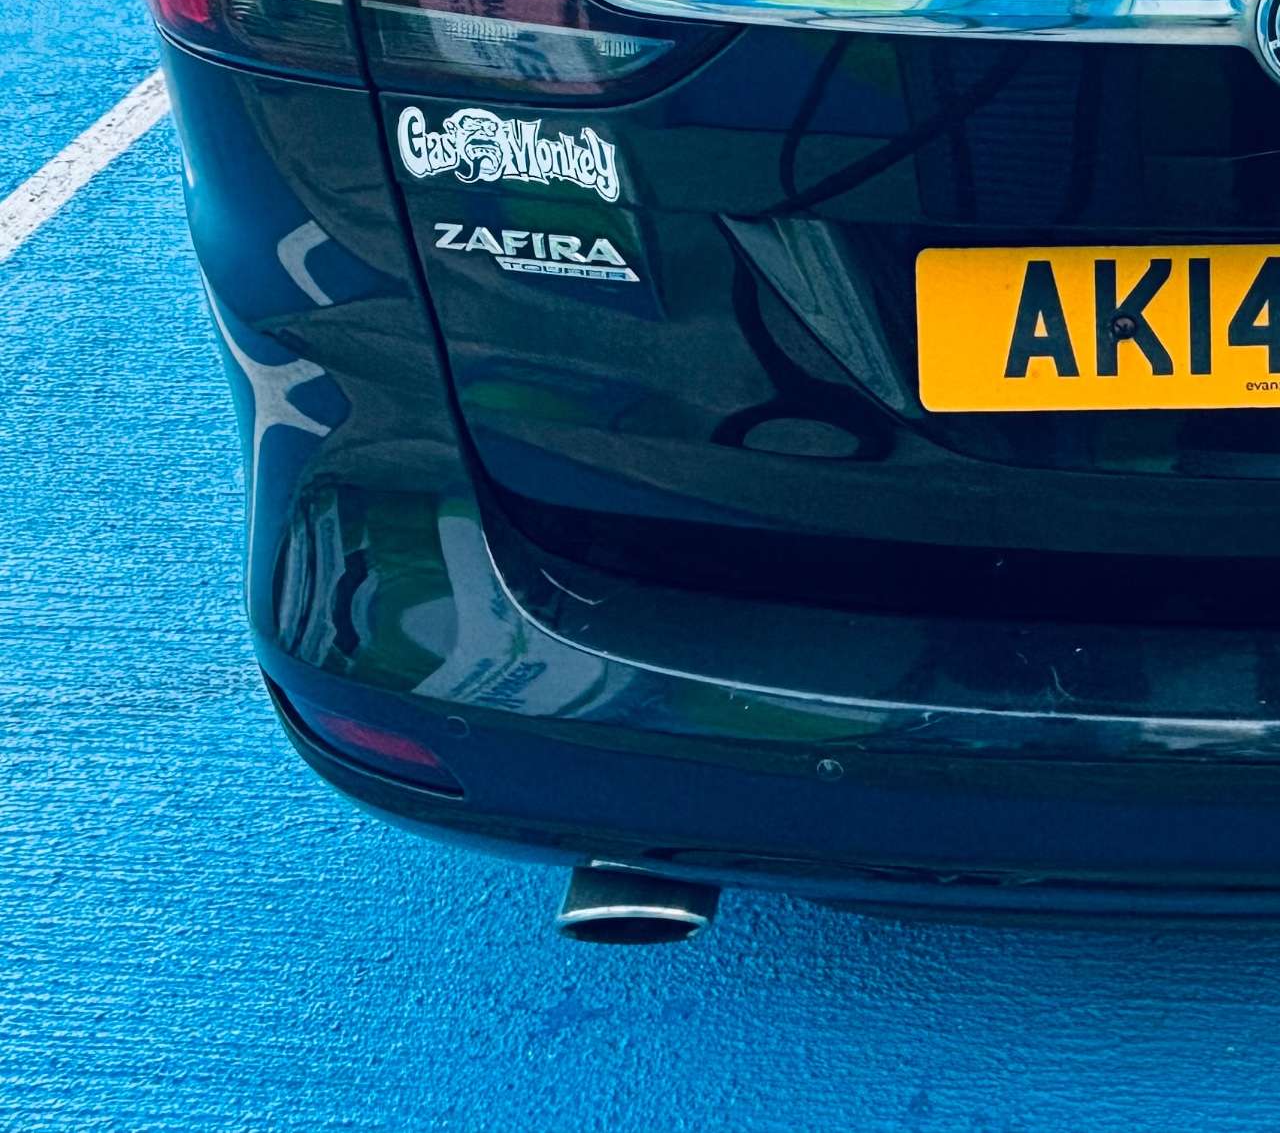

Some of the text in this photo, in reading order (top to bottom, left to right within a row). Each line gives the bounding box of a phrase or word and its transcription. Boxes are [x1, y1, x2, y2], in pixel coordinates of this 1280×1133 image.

[397, 106, 620, 202] Gas Monkey
[434, 222, 627, 266] ZAFIRA
